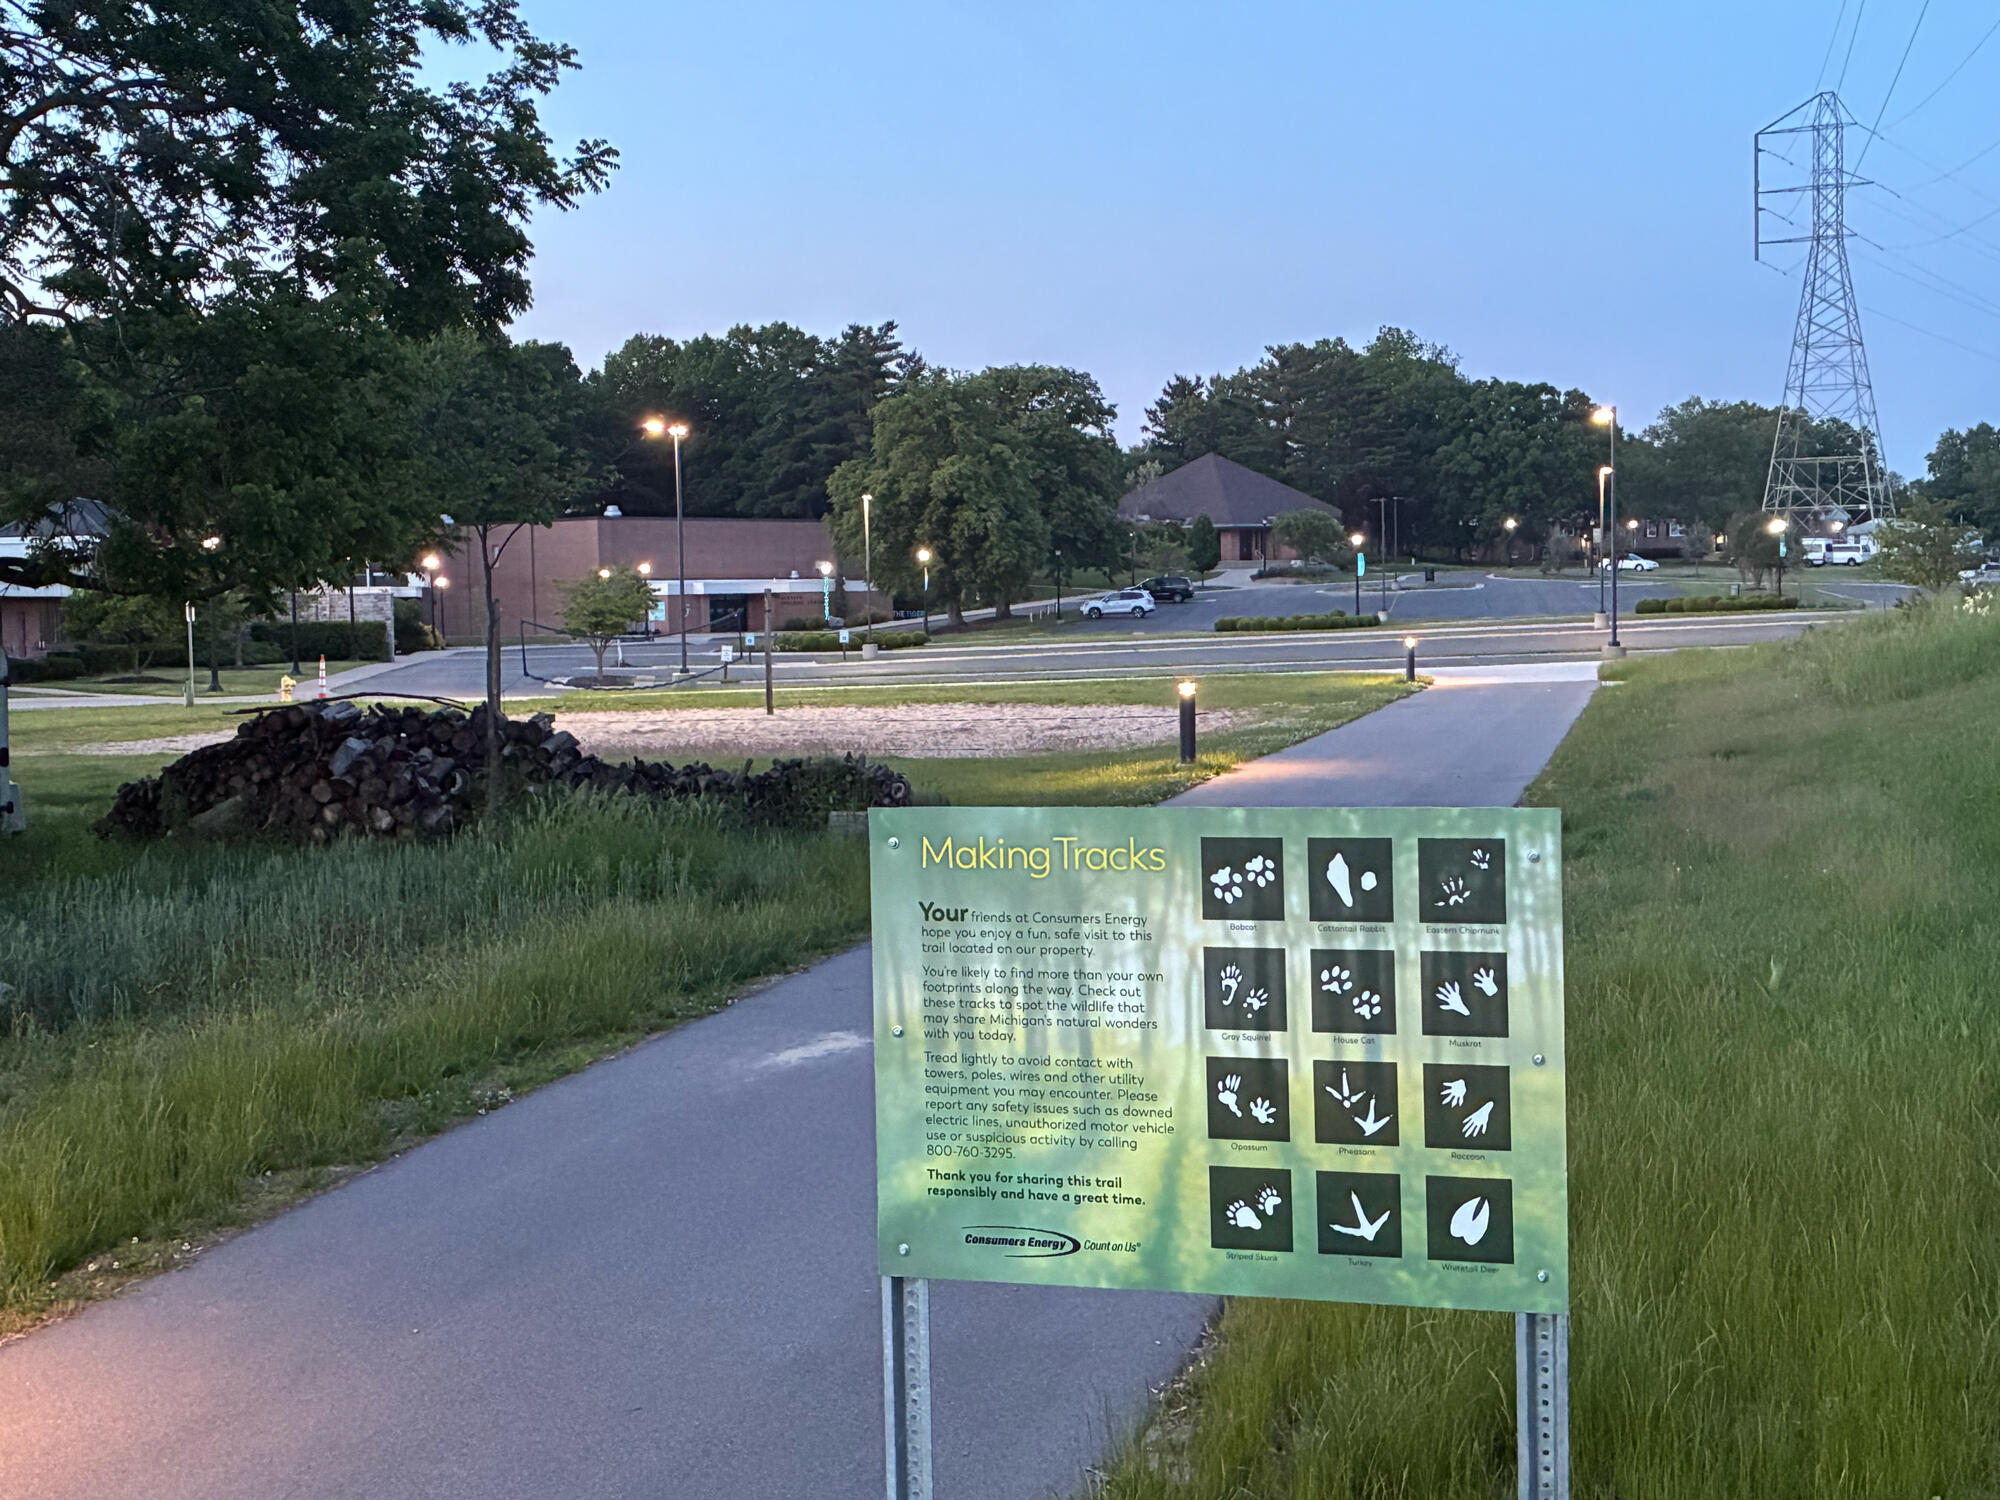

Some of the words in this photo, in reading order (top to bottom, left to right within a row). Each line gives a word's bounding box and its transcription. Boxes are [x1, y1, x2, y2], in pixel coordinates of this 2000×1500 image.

[922, 836, 1050, 878] Making
[1054, 837, 1165, 871] Tracks
[919, 902, 968, 922] Your
[971, 911, 1011, 922] friends
[1016, 913, 1027, 923] at
[1032, 913, 1100, 924] Consumers
[1105, 913, 1147, 927] Energy
[922, 927, 950, 939] hope
[955, 929, 975, 940] you
[980, 928, 1010, 941] enjoy
[1016, 931, 1023, 939] a
[1055, 929, 1080, 940] safe
[1084, 929, 1107, 940] visit
[1112, 931, 1125, 941] to
[1130, 930, 1152, 941] this
[922, 943, 945, 953] trail
[949, 943, 993, 954] located
[997, 946, 1012, 954] on
[1017, 946, 1036, 954] our
[1040, 946, 1095, 957] property.
[923, 966, 957, 978] You're
[962, 967, 989, 979] likely
[995, 969, 1006, 978] to
[1011, 968, 1033, 978] find
[1038, 971, 1069, 980] more
[1074, 969, 1102, 980] than
[1107, 972, 1133, 983] your
[1138, 973, 1163, 981] own
[923, 982, 981, 994] footprints
[985, 984, 1018, 996] along
[1023, 984, 1043, 994] the
[1047, 987, 1073, 997] way.
[1079, 986, 1115, 996] Check
[1120, 987, 1140, 997] out
[923, 998, 955, 1008] these
[960, 999, 995, 1009] tracks
[1000, 1000, 1012, 1009] to
[1016, 1001, 1043, 1011] spot
[1047, 1000, 1067, 1011] the
[1071, 1001, 1114, 1012] wildlife
[1118, 1002, 1144, 1013] that
[923, 1015, 949, 1026] may
[953, 1014, 985, 1024] share
[990, 1015, 1052, 1027] Michigan's
[1057, 1017, 1101, 1027] natural
[1105, 1018, 1157, 1029] wonders
[924, 1029, 949, 1039] with
[953, 1031, 974, 1042] you
[979, 1030, 1016, 1042] today.
[1334, 1036, 1358, 1044] House
[1360, 1036, 1375, 1044] Cat
[1449, 1039, 1482, 1048] Muskrat
[924, 1052, 957, 1063] Tread
[962, 1053, 997, 1066] lightly
[1002, 1055, 1014, 1065] to
[1018, 1056, 1051, 1066] avoid
[1055, 1057, 1102, 1068] contact
[1107, 1058, 1133, 1068] with
[924, 1069, 968, 1080] towers,
[972, 1071, 1006, 1083] poles,
[1010, 1072, 1040, 1081] wires
[1045, 1072, 1067, 1083] and
[1072, 1073, 1104, 1084] other
[1109, 1074, 1144, 1087] utility
[925, 1085, 989, 1097] equipment
[993, 1088, 1014, 1099] you
[1019, 1089, 1045, 1100] may
[1049, 1089, 1112, 1099] encounter.
[1118, 1089, 1158, 1101] Please
[925, 1101, 962, 1112] report
[966, 1103, 987, 1113] any
[992, 1102, 1029, 1115] safety
[1033, 1103, 1069, 1115] issues
[1073, 1105, 1100, 1116] such
[1105, 1107, 1119, 1116] as
[1123, 1107, 1172, 1118] downed
[926, 1116, 968, 1126] electric
[972, 1116, 1002, 1129] lines,
[1006, 1117, 1086, 1131] unauthorized
[1091, 1121, 1128, 1132] motor
[1133, 1122, 1174, 1134] vehicle
[927, 1132, 945, 1141] use
[950, 1133, 962, 1141] or
[966, 1132, 1026, 1145] suspicious
[1030, 1134, 1075, 1148] activity
[1079, 1135, 1094, 1148] by
[1098, 1137, 1137, 1151] calling
[1231, 1143, 1267, 1153] Opossum
[927, 1145, 1016, 1159] 800-760-3295.
[1338, 1148, 1375, 1156] Pheasant
[1451, 1153, 1485, 1161] Raccoon
[927, 1170, 965, 1181] Thank
[970, 1172, 991, 1183] you
[995, 1172, 1013, 1183] for
[1017, 1173, 1063, 1188] sharing
[1068, 1175, 1092, 1186] this
[1096, 1175, 1122, 1188] trail
[928, 1186, 997, 1200] responsibly
[1001, 1188, 1024, 1199] and
[1028, 1189, 1058, 1200] have
[1063, 1193, 1070, 1201] a
[1074, 1192, 1108, 1204] great
[1112, 1193, 1145, 1205] time.
[965, 1233, 1026, 1246] Consumers
[1028, 1237, 1066, 1250] Energy
[1084, 1240, 1110, 1251] Count
[1112, 1243, 1123, 1252] on
